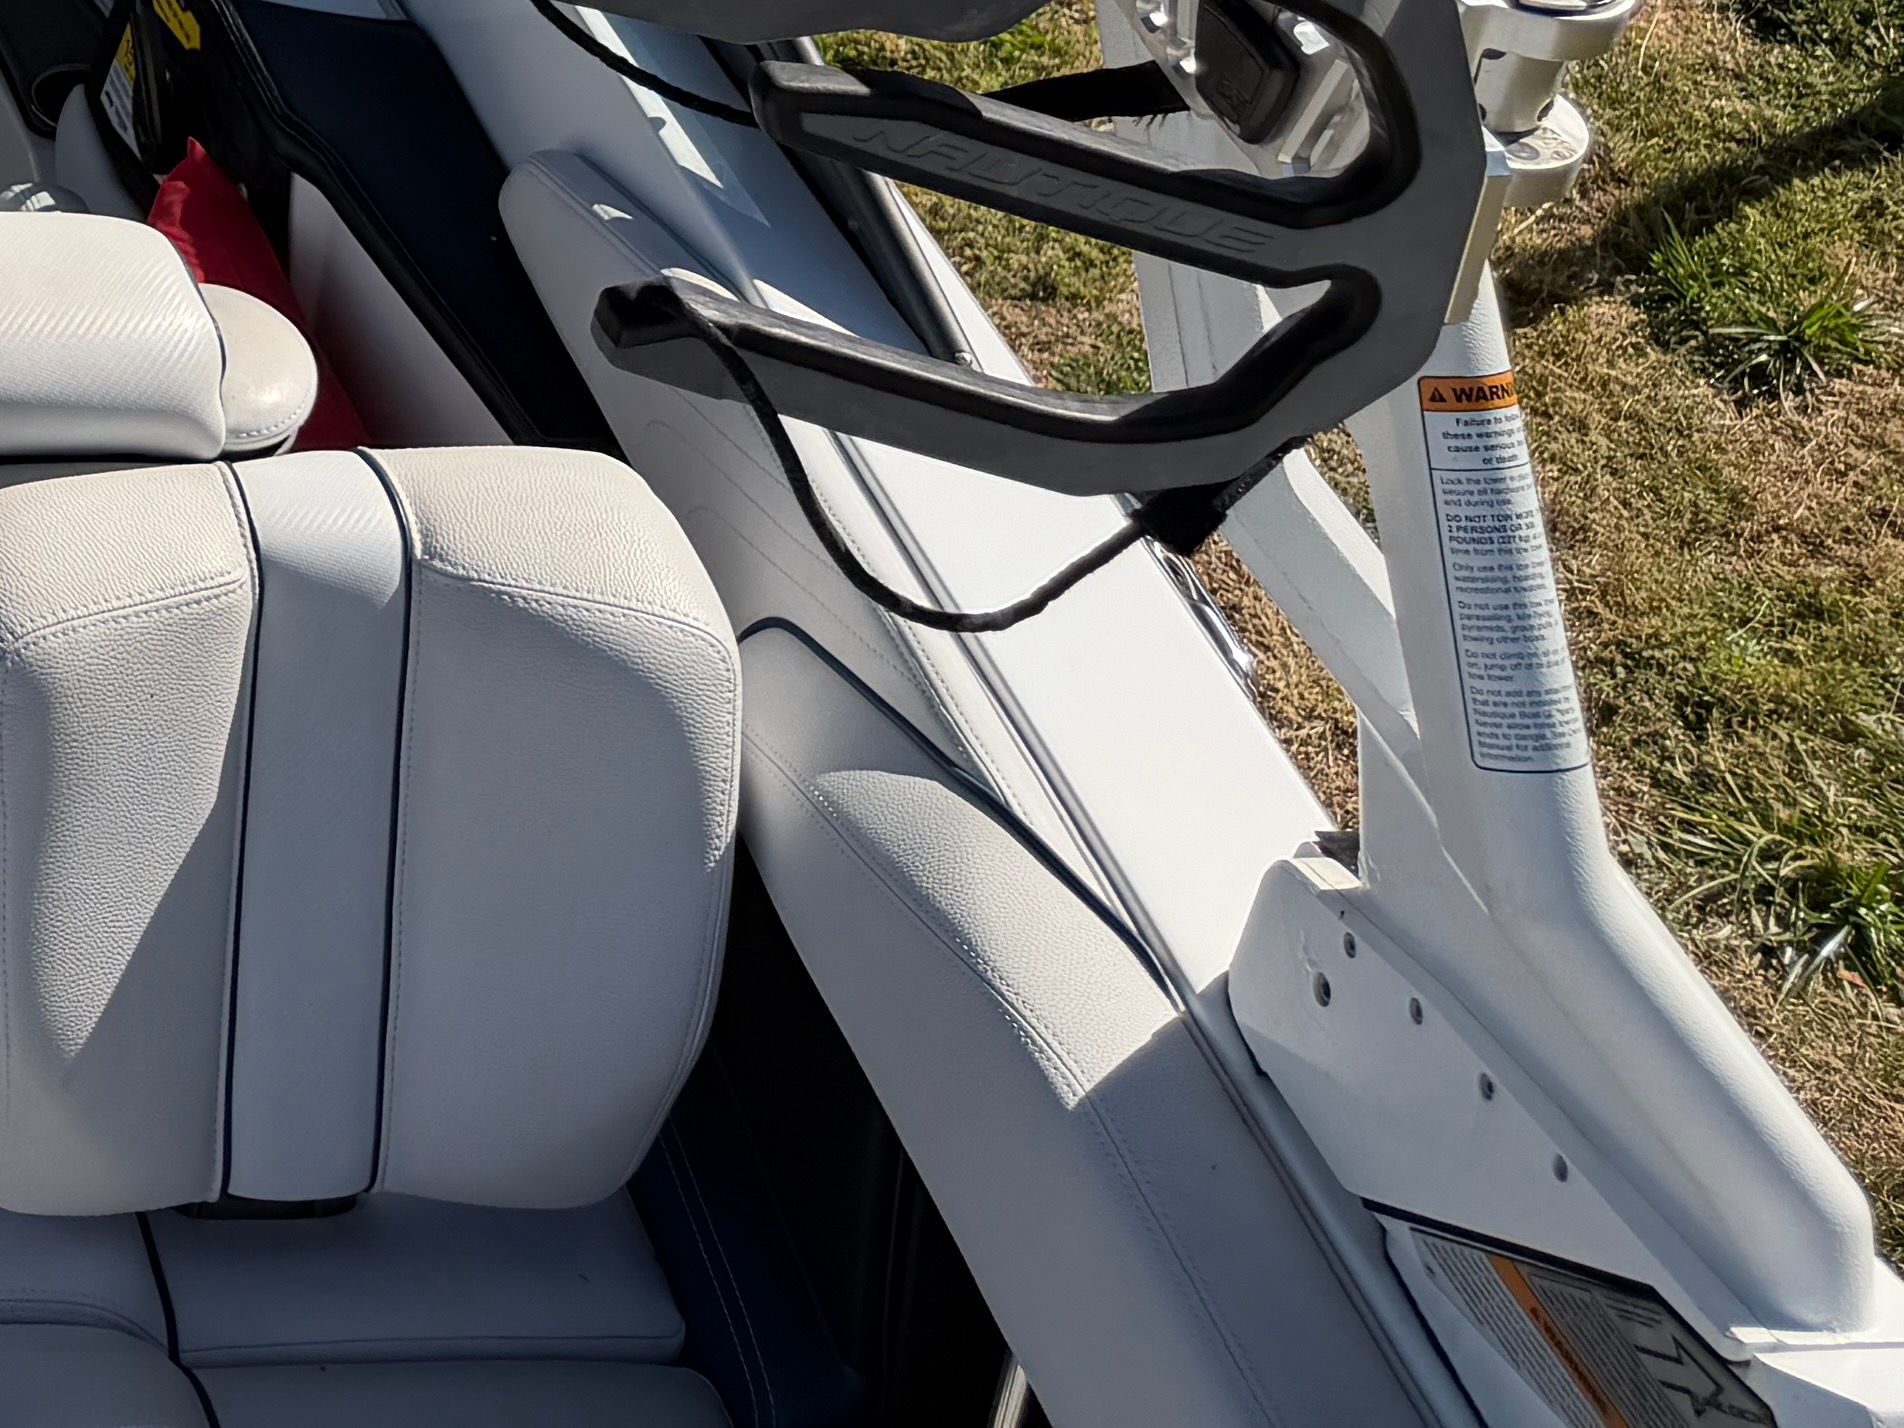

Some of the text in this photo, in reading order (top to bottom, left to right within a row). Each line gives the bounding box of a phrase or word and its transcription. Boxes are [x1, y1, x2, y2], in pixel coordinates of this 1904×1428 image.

[1451, 381, 1512, 403] WARN
[1442, 430, 1473, 440] these
[1447, 444, 1480, 453] cause
[1445, 513, 1462, 523] DO
[1456, 525, 1508, 535] PERSONS
